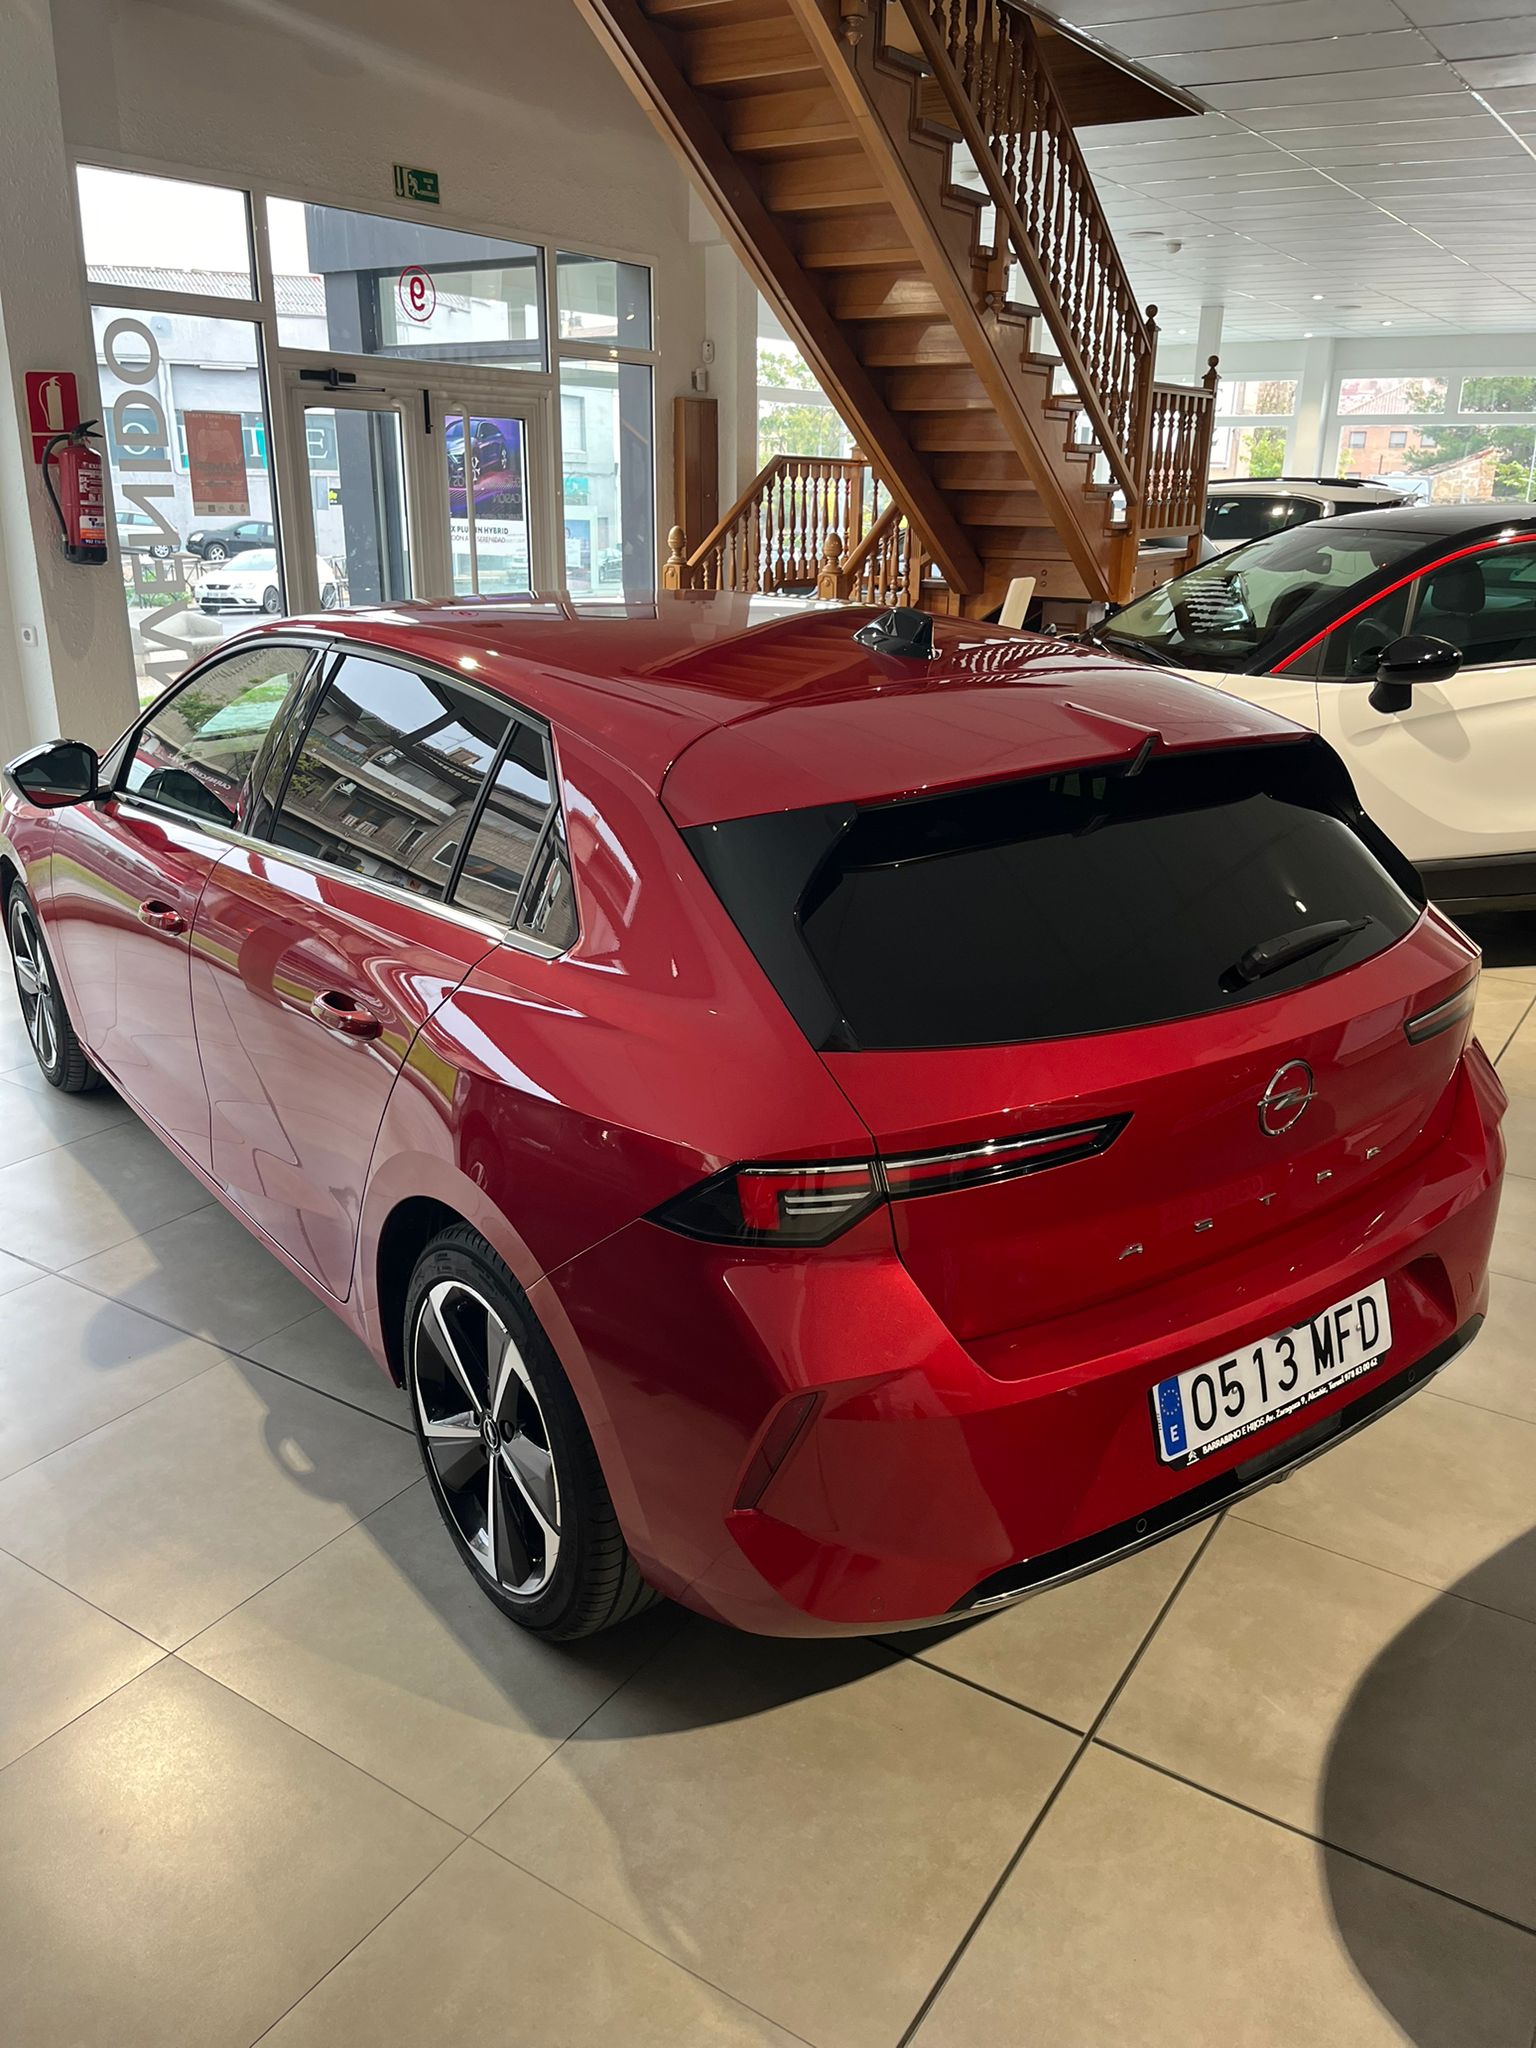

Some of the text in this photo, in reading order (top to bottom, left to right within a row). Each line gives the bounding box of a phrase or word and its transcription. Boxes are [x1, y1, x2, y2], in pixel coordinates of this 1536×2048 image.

[484, 526, 509, 535] HYBRID
[1191, 1296, 1379, 1430] 0513 MFD
[1246, 1416, 1266, 1433] HIJOS
[1265, 1415, 1276, 1424] Av.
[1276, 1400, 1301, 1418] Zaragoza
[1169, 1424, 1180, 1443] E
